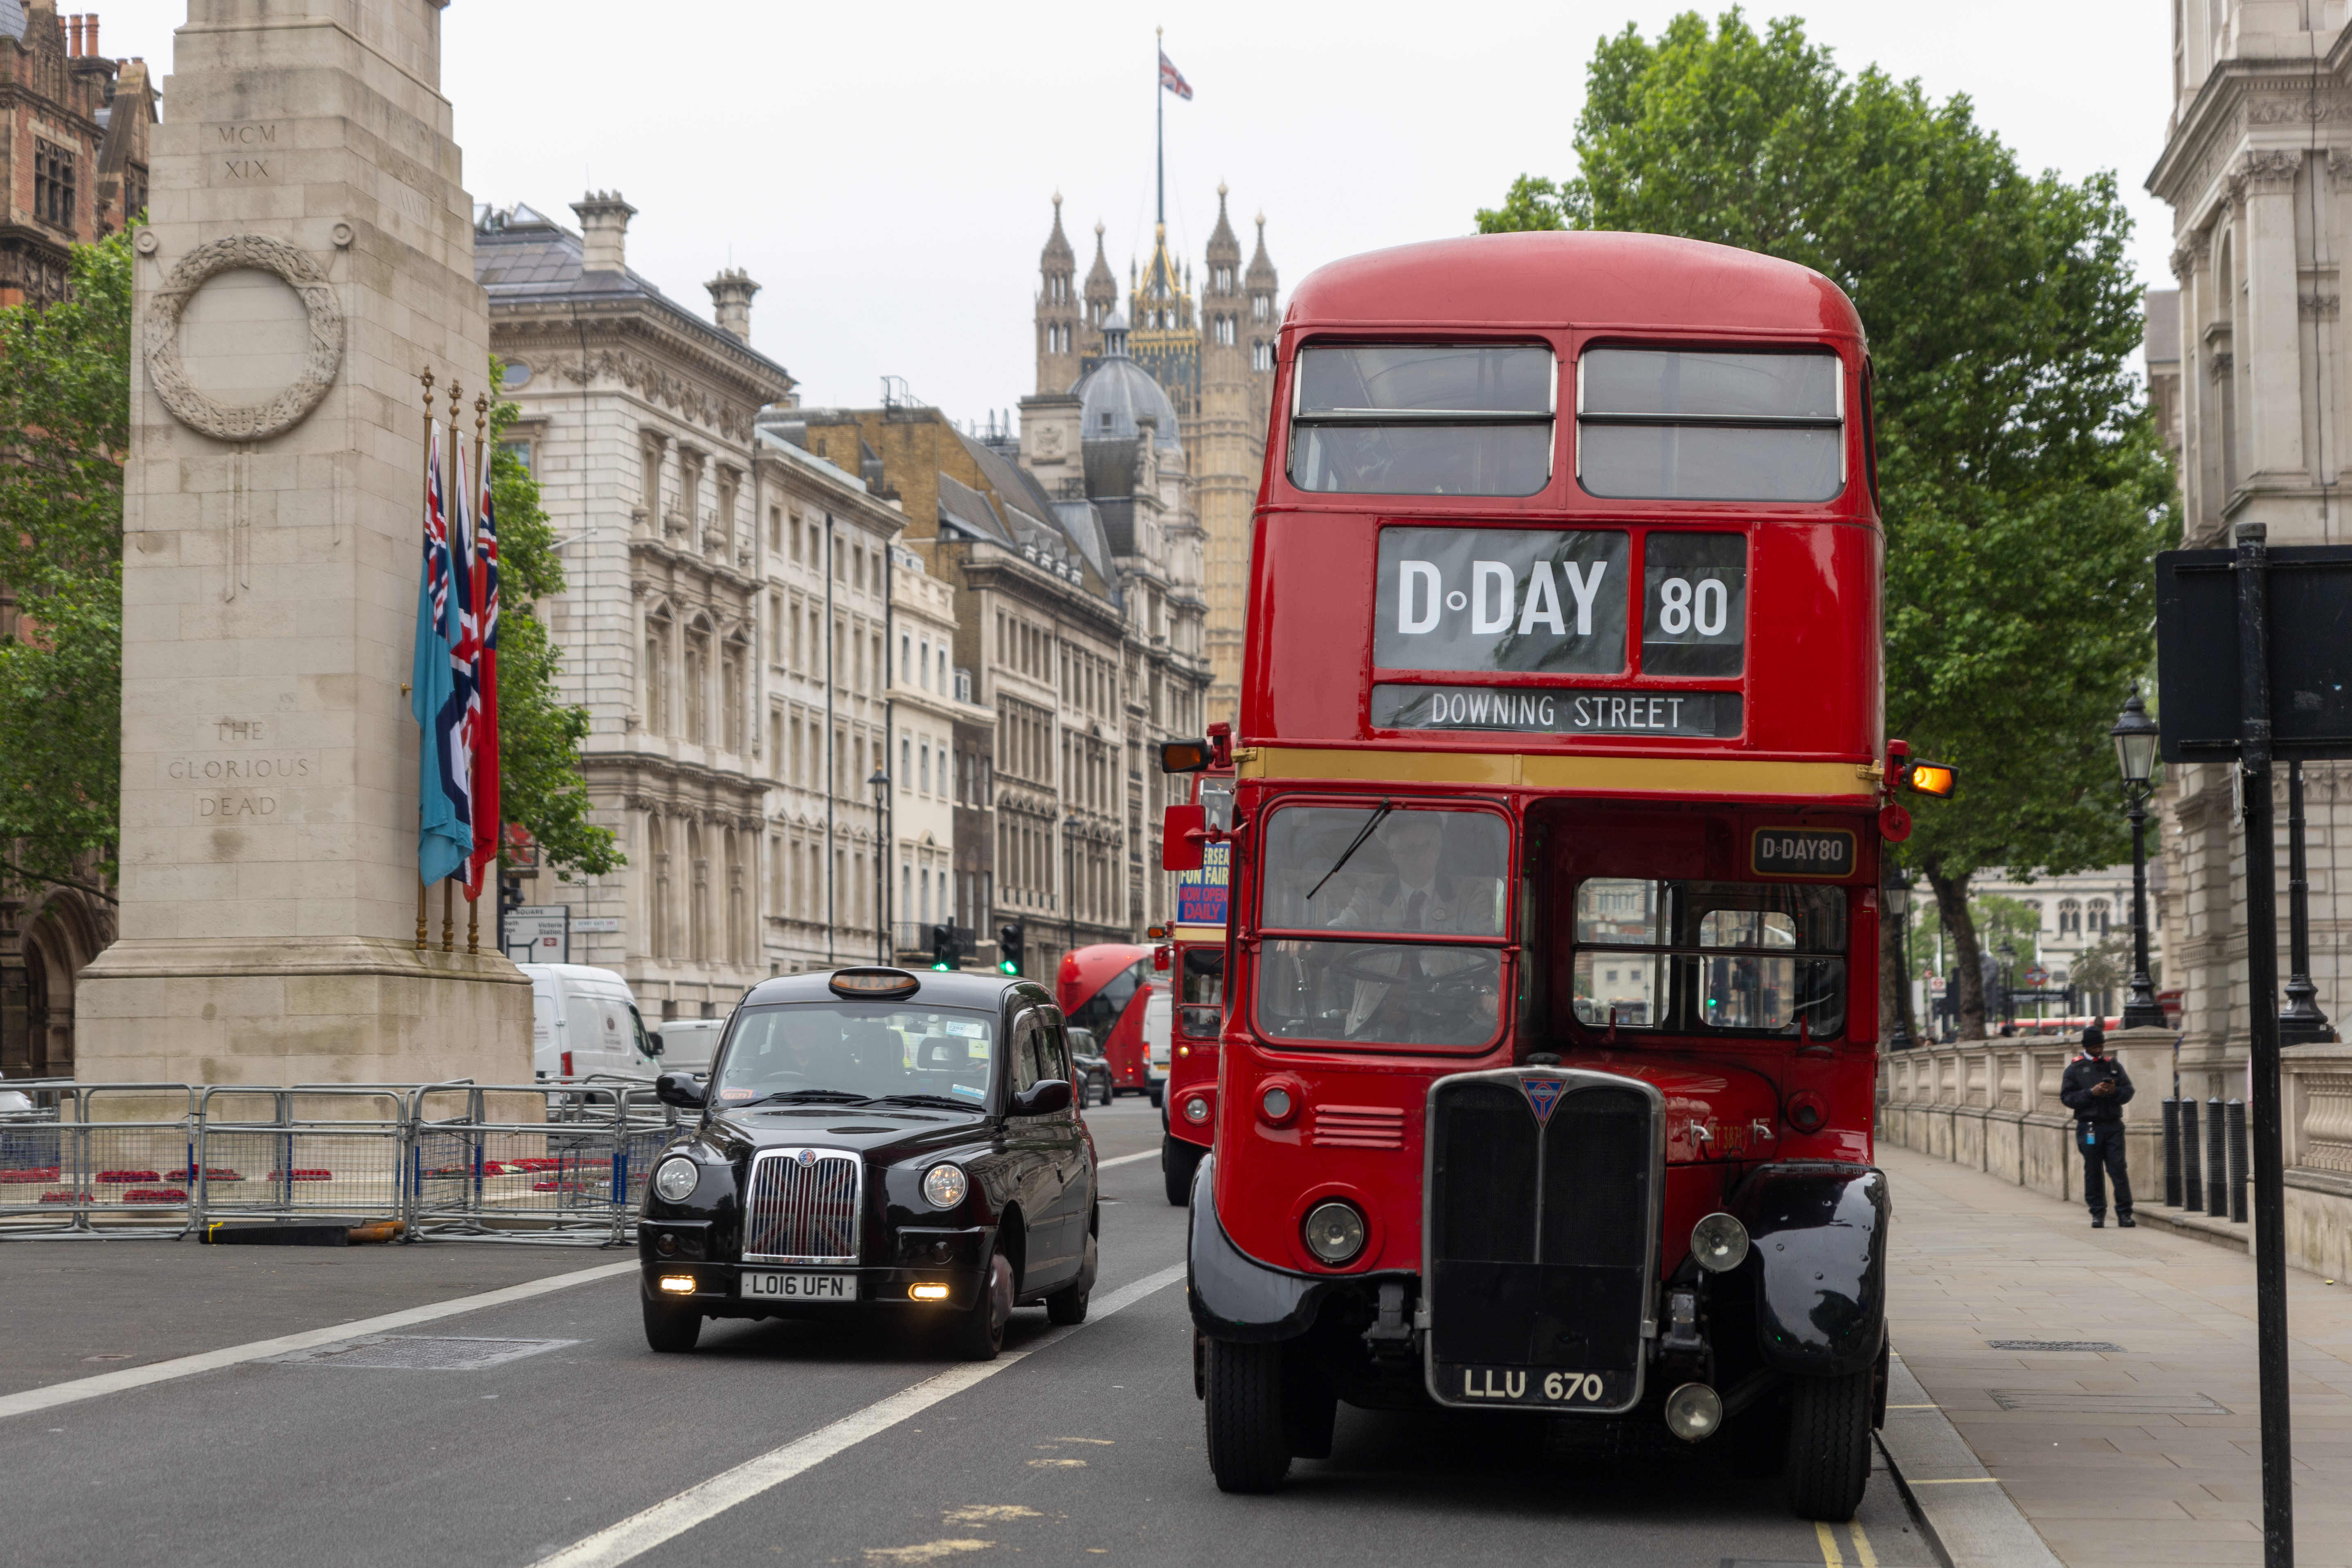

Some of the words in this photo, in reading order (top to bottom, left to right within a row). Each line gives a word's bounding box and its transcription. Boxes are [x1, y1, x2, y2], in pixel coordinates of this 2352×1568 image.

[218, 125, 276, 145] MCM
[224, 160, 270, 179] XIX
[1660, 577, 1727, 636] 80
[1432, 693, 1554, 725] DOWNING
[1575, 696, 1684, 728] STREET
[214, 721, 264, 741] THE
[169, 758, 308, 779] GLORIOUS
[199, 796, 276, 817] DEAD
[1204, 847, 1229, 865] ERSEA
[1181, 869, 1202, 884] FUN
[1205, 866, 1229, 885] FAIR
[1179, 887, 1201, 901] NOW
[1203, 888, 1228, 902] OPEN
[1184, 903, 1221, 920] DAILY
[847, 974, 898, 988] TAXI
[752, 1274, 797, 1295] LO16
[803, 1276, 844, 1297] UFN
[1464, 1369, 1525, 1398] LLU
[1544, 1372, 1603, 1401] 670
